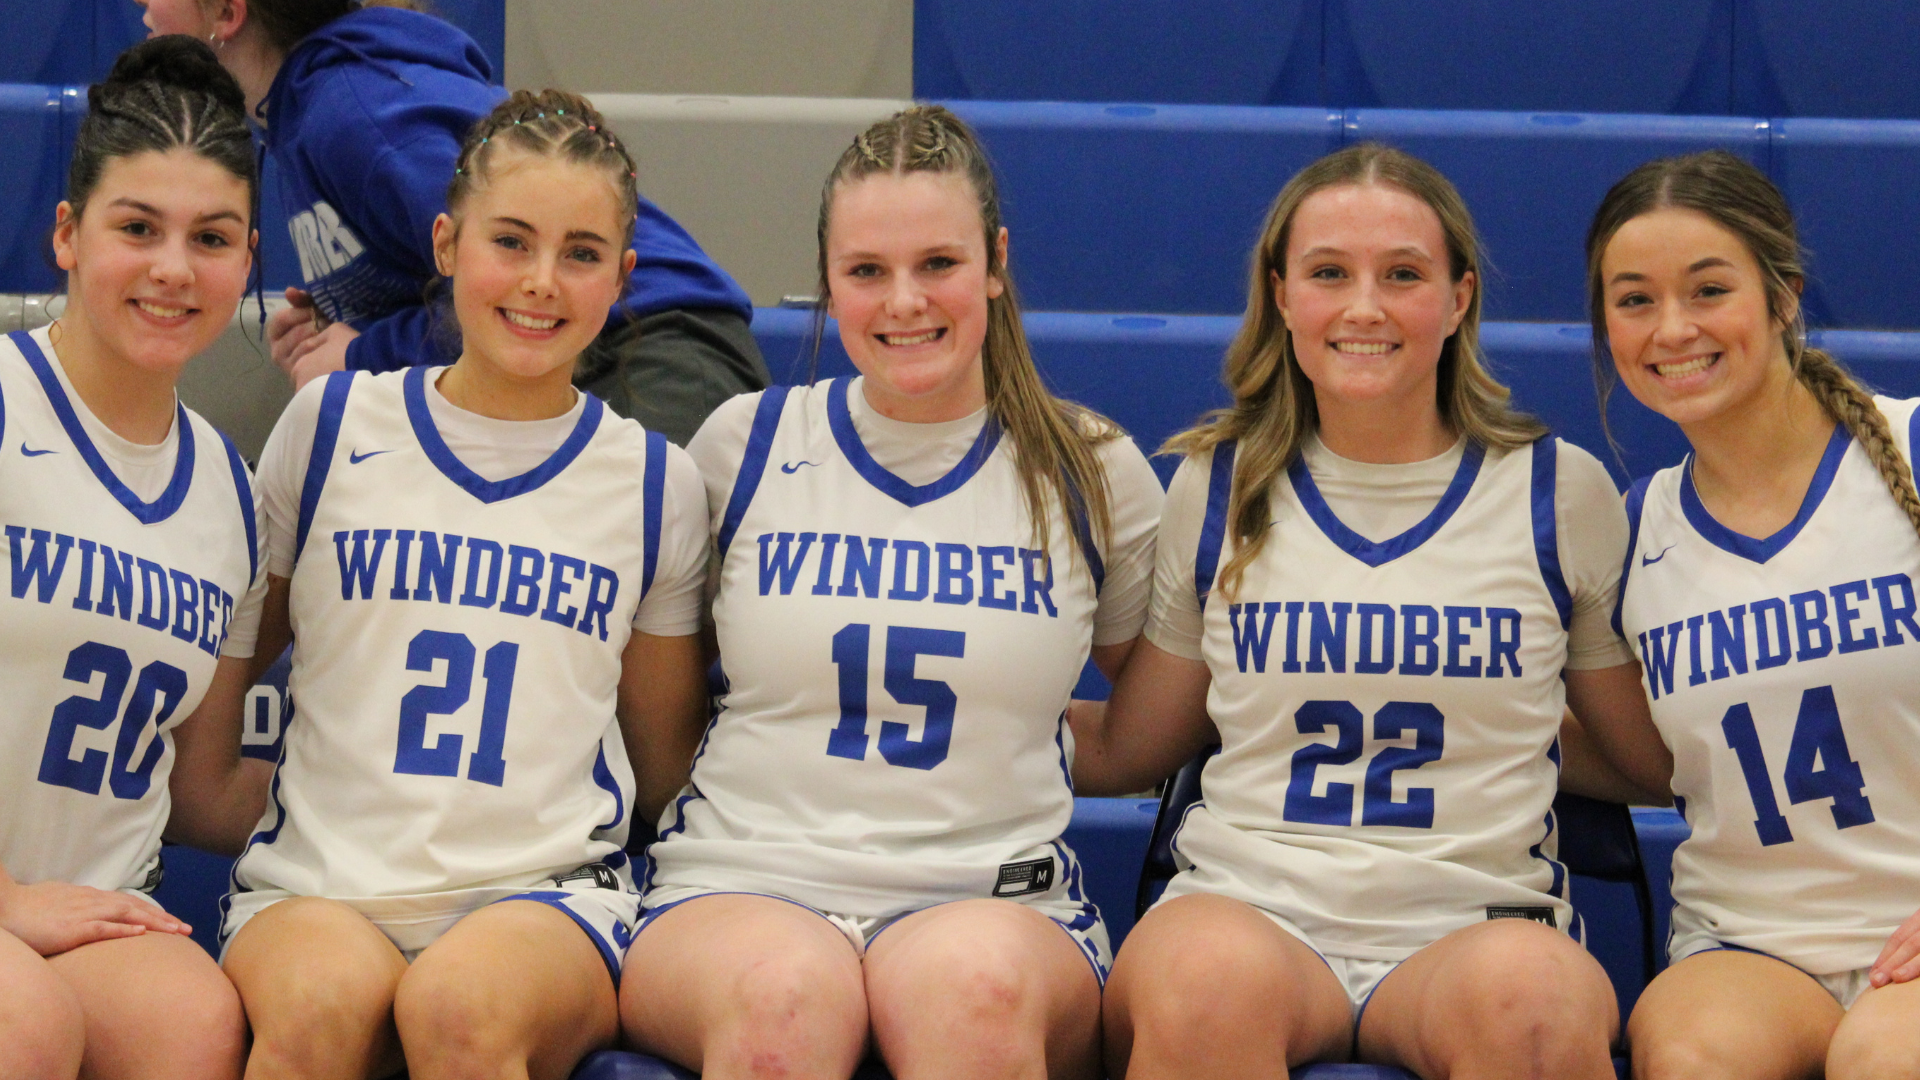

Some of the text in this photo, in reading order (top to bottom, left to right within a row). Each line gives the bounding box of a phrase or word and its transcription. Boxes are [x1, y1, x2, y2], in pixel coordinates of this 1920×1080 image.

[334, 529, 620, 642] WINDBER
[757, 532, 1058, 618] WINDBER
[1638, 572, 1920, 701] WINDBER
[826, 622, 966, 771] 15
[1229, 602, 1522, 679] WINDBER
[37, 641, 188, 801] 20
[393, 629, 519, 788] 21
[1283, 699, 1445, 828] 22
[1721, 685, 1876, 847] 14
[598, 870, 611, 884] M
[1036, 869, 1048, 884] M
